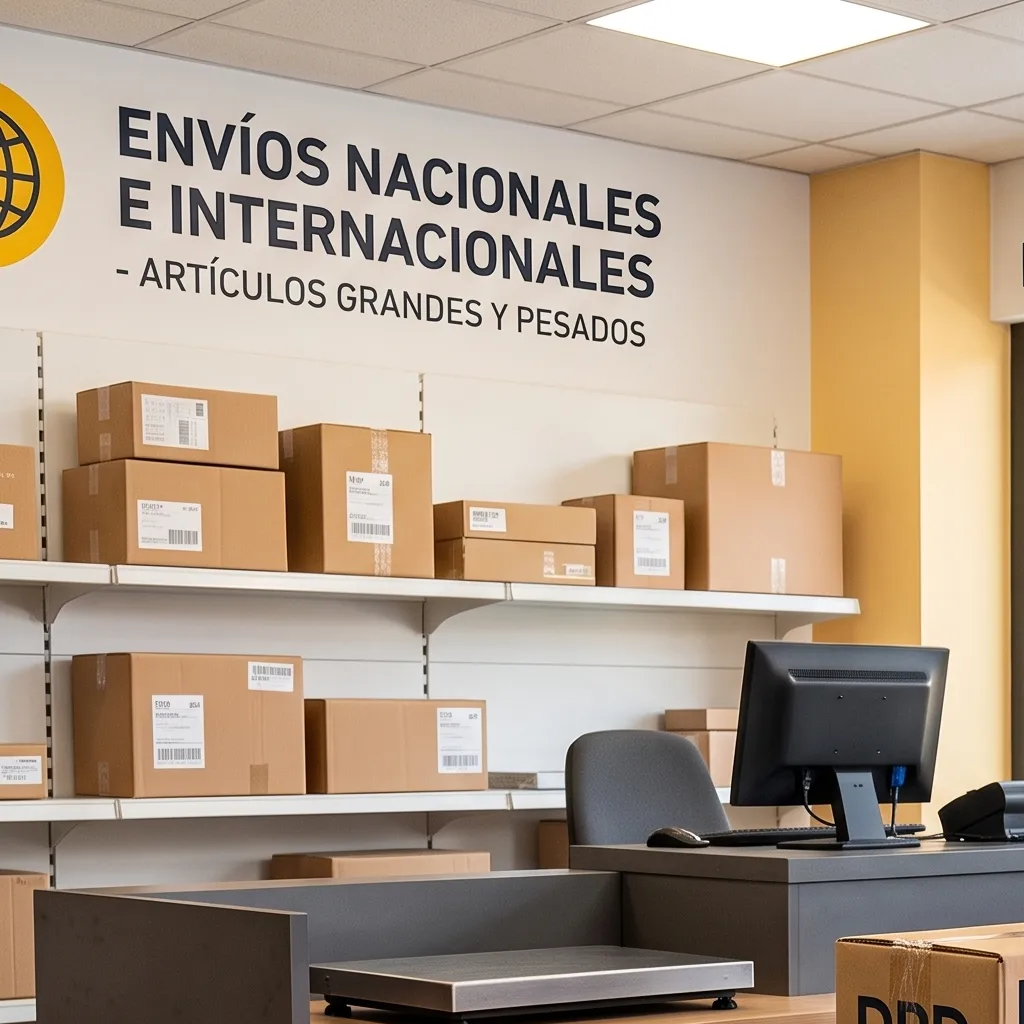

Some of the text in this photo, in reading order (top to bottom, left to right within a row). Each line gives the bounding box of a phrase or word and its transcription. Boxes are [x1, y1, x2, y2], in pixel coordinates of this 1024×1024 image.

[118, 106, 662, 239] ENVÍOS NACIONALES
[118, 177, 655, 299] E INTERNACIONALES
[139, 256, 326, 309] ARTÍCULOS
[336, 282, 483, 329] GRANDES
[490, 303, 509, 331] Y
[517, 307, 647, 348] PESADOS
